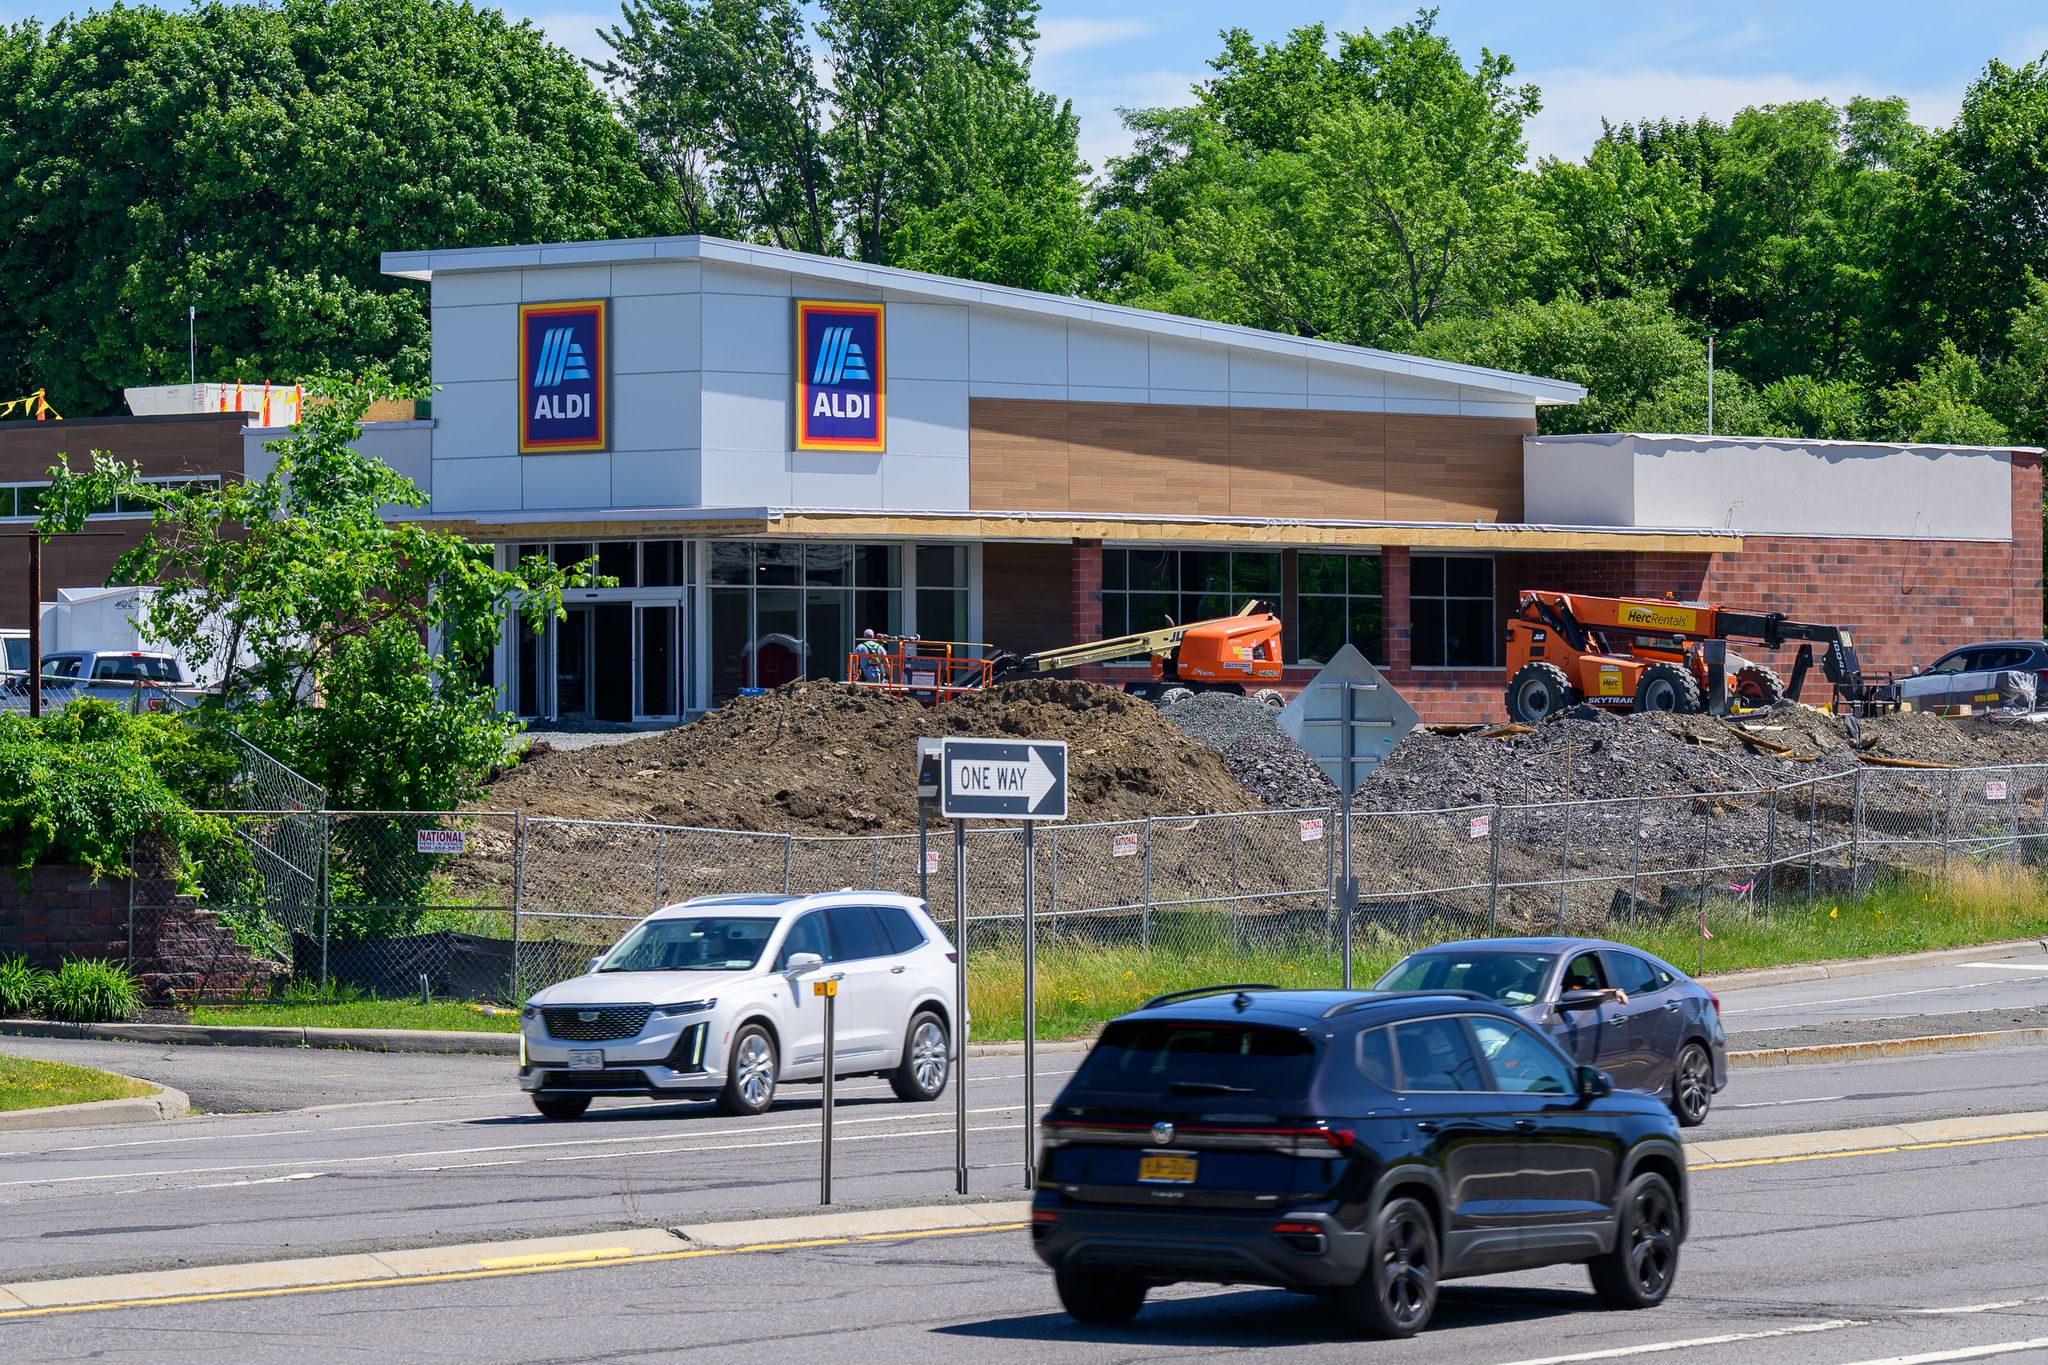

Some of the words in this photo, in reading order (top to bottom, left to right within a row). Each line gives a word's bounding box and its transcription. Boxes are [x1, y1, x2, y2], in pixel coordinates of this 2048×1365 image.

[534, 393, 591, 420] ALDI
[813, 392, 871, 419] ALDI
[1628, 610, 1687, 627] HercRentals
[1169, 631, 1184, 642] JL
[1603, 679, 1619, 687] Herc
[961, 766, 991, 790] ONE
[997, 767, 1027, 791] WAY
[419, 831, 464, 842] NATIONAL
